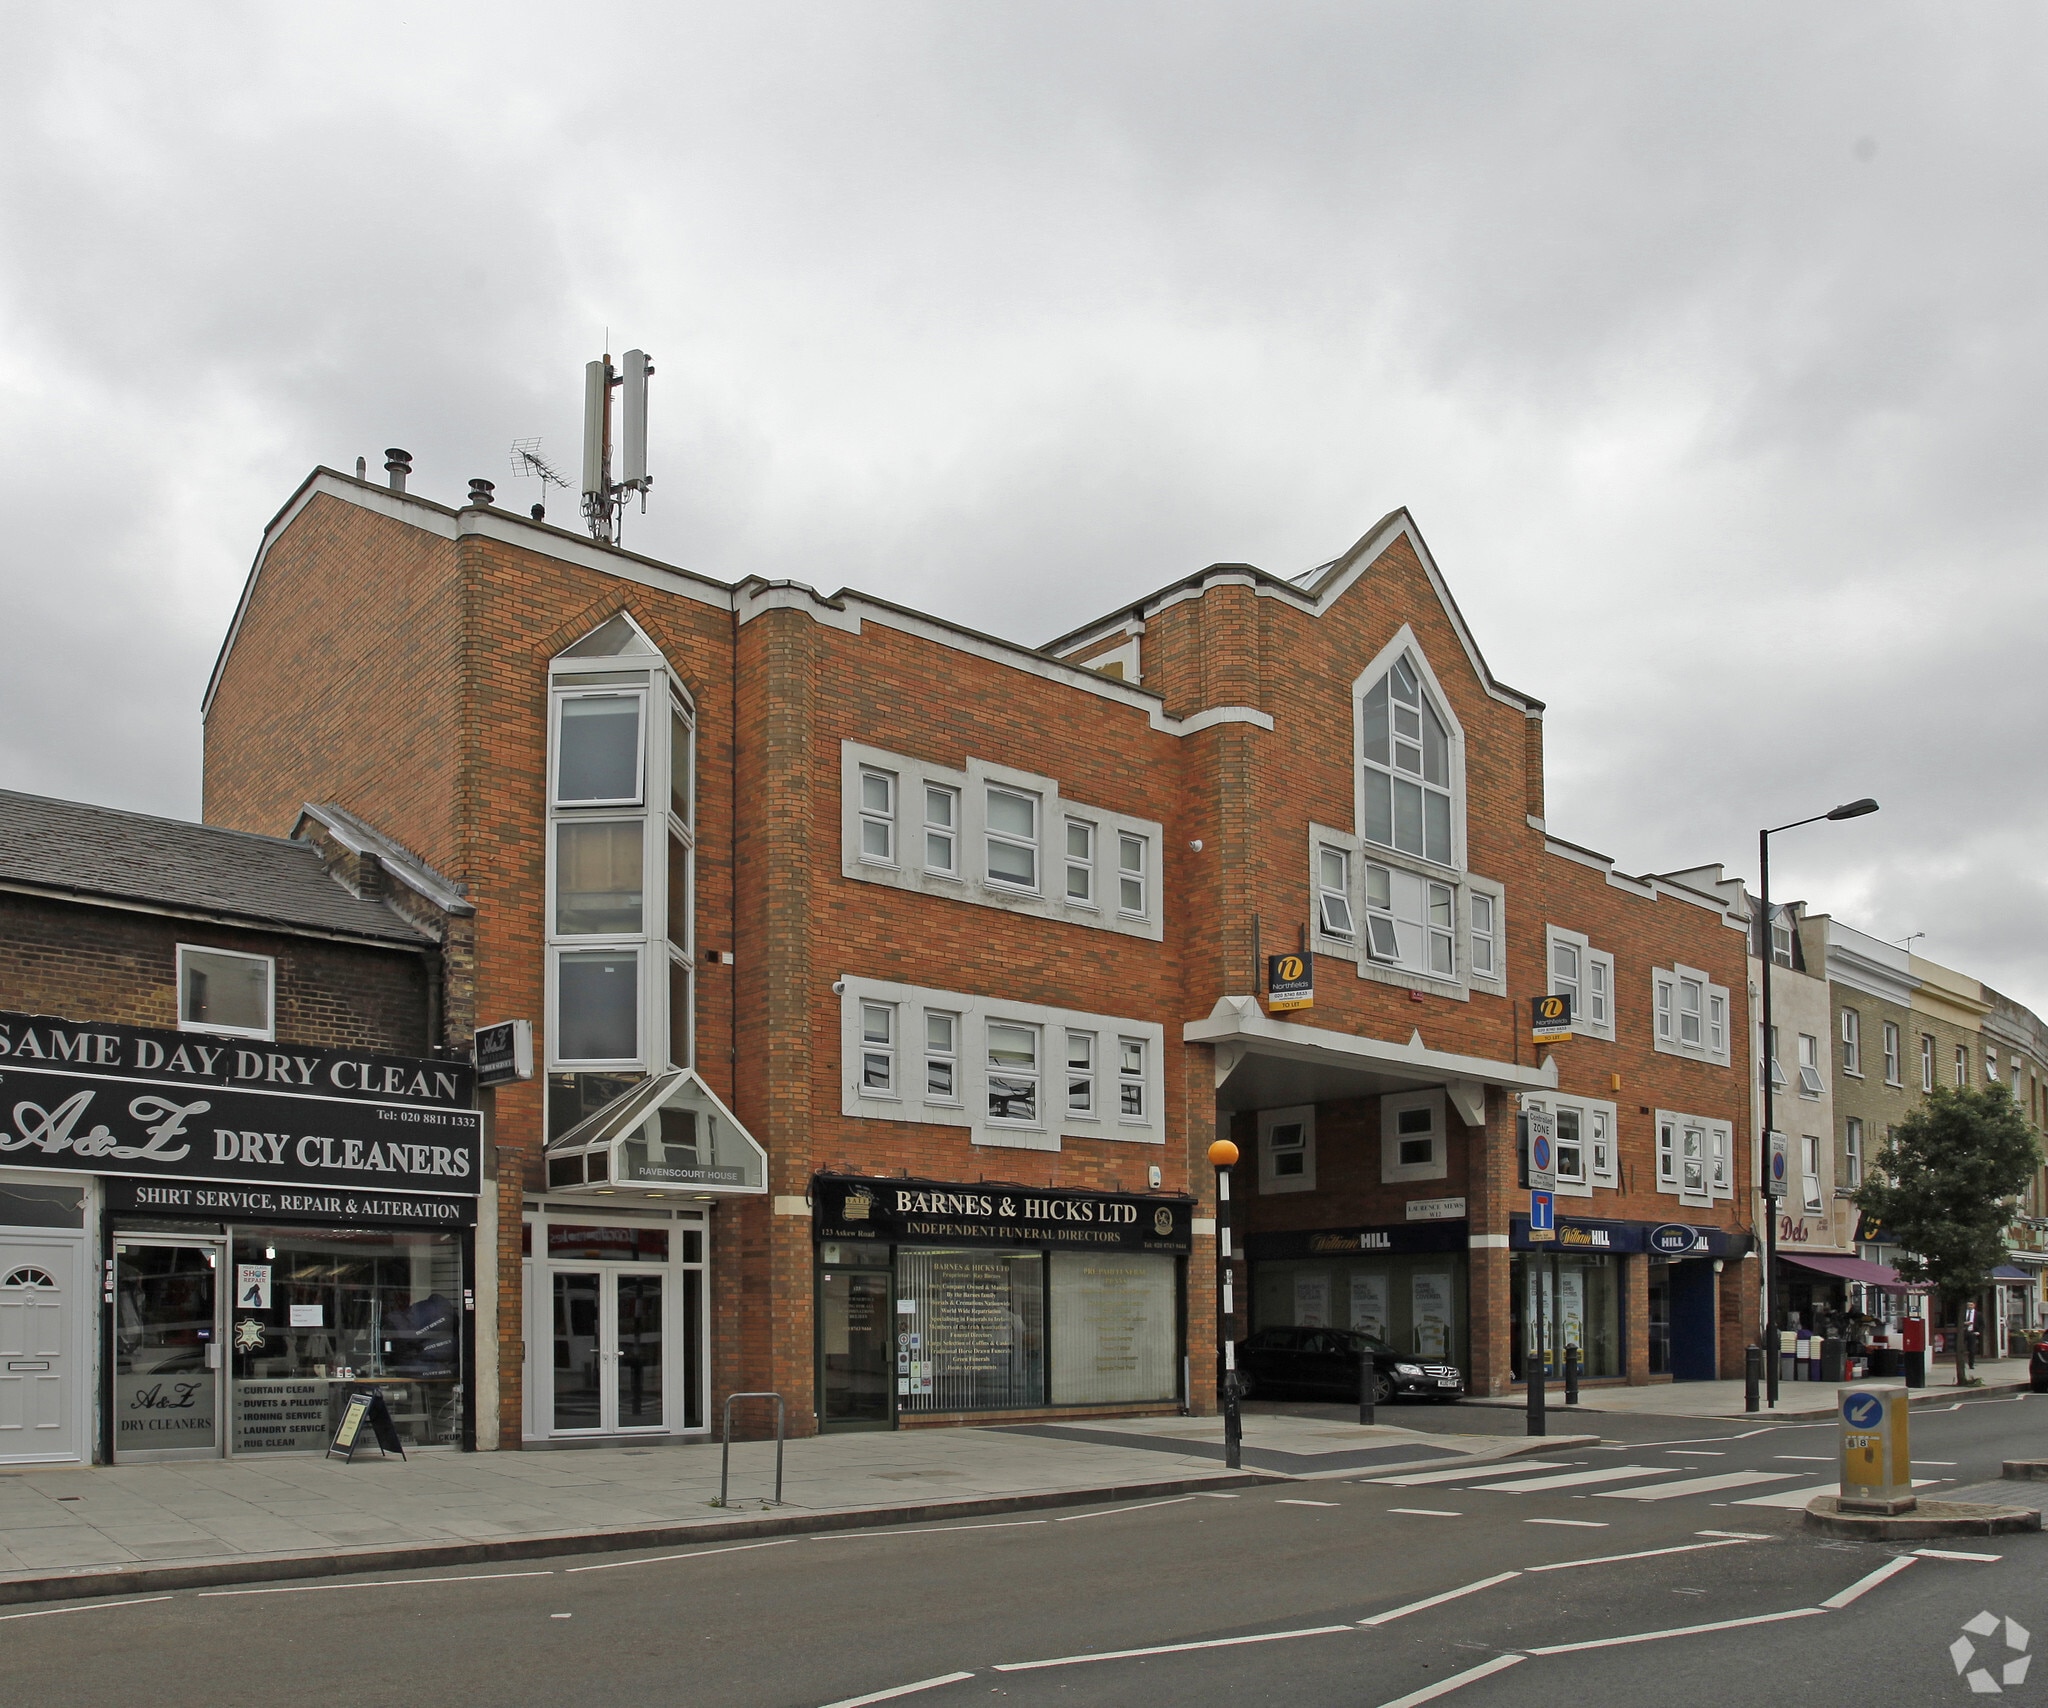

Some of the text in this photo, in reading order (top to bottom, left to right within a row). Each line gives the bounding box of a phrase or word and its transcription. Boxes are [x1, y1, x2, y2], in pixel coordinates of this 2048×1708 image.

[1272, 981, 1308, 990] Northfields
[0, 1023, 458, 1100] SAME DAY DRY CLEAN
[376, 1110, 476, 1128] Tel: 020 8811 1332
[1530, 1112, 1552, 1125] Controlled
[0, 1090, 211, 1162] A&Z
[1534, 1123, 1550, 1135] ZONE
[214, 1129, 470, 1177] DRY CLEANERS
[1773, 1142, 1784, 1151] ZONE
[639, 1167, 738, 1181] RAVENSCOURT HOUSE
[136, 1186, 460, 1219] SHIRT SERVICE, REPAIR & ALTERATION
[896, 1190, 1138, 1223] BARNES & HICKS LTD
[1408, 1204, 1440, 1212] LAURENCE
[822, 1228, 834, 1236] 123
[858, 1230, 876, 1238] Road
[907, 1222, 1120, 1242] INDEPENDENT FUNERAL DIRECTORS
[1559, 1226, 1592, 1245] William
[1592, 1230, 1610, 1245] HILL
[1780, 1216, 1808, 1242] Dels
[1312, 1232, 1391, 1250] William HILL
[1662, 1237, 1684, 1247] HILL
[130, 1383, 202, 1409] A&Z
[244, 1386, 283, 1394] CURTAIN
[244, 1400, 278, 1408] DUVETS
[290, 1399, 328, 1407] PILLOWS
[244, 1413, 282, 1421] IRONING
[121, 1418, 212, 1431] DRY CLEANERS
[244, 1424, 326, 1434] LAUNDRY SERVICE
[266, 1438, 295, 1446] CLEAN
